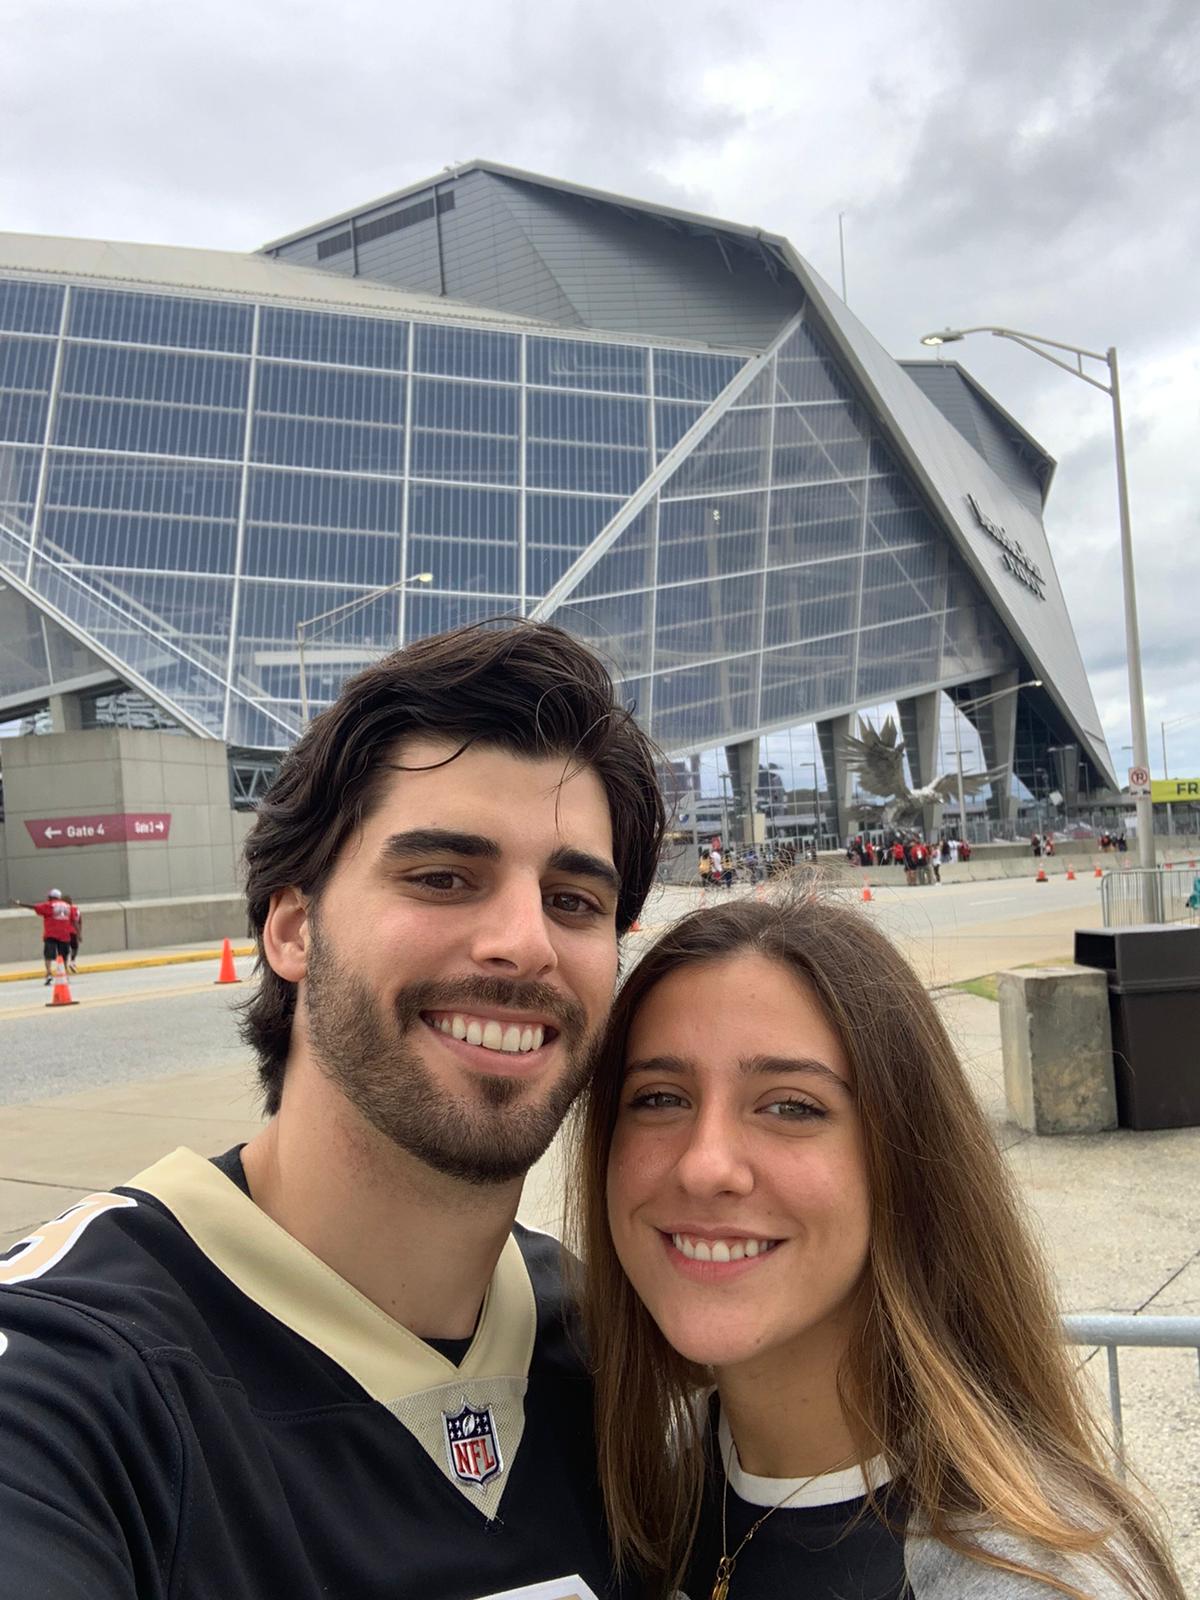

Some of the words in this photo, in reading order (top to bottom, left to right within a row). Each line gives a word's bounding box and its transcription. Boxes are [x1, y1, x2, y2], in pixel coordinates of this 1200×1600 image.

[1177, 781, 1199, 796] FR
[67, 825, 94, 838] Gate
[96, 823, 105, 836] 4
[454, 1439, 496, 1476] NFL
